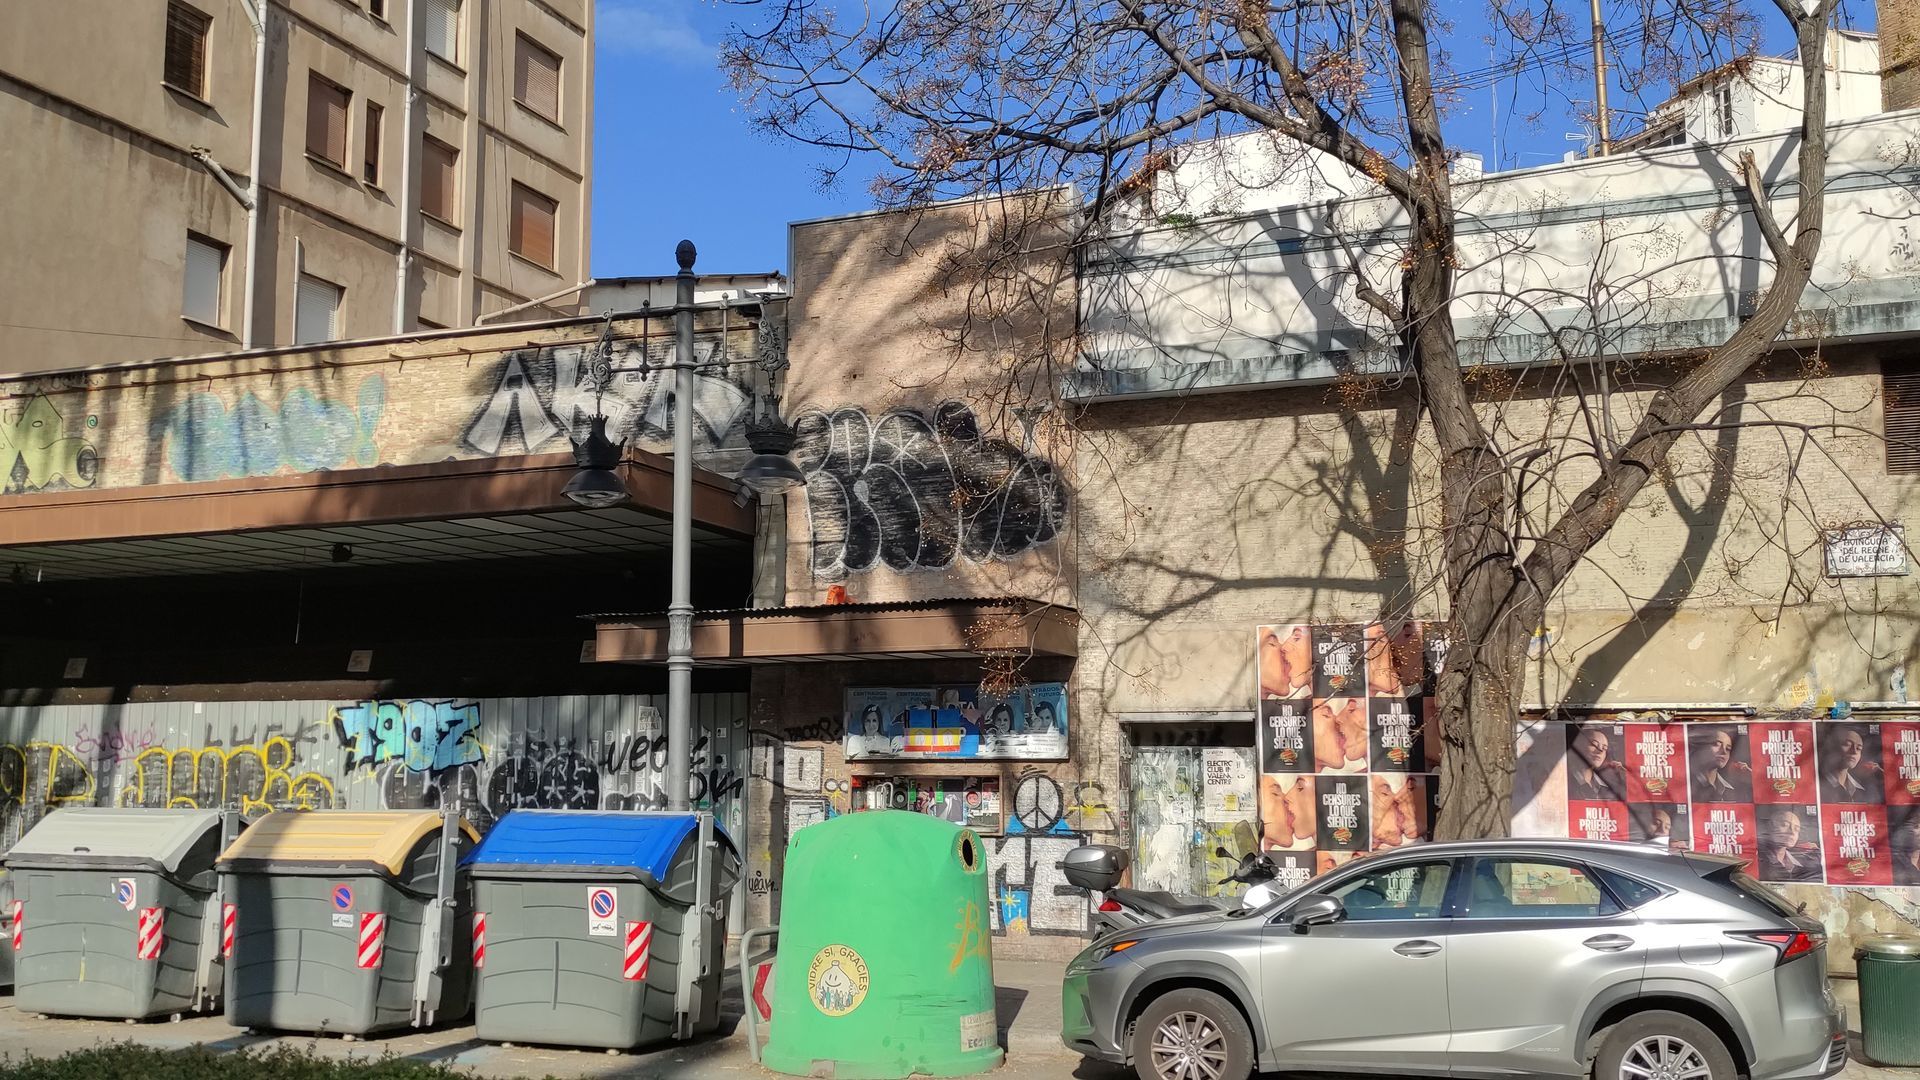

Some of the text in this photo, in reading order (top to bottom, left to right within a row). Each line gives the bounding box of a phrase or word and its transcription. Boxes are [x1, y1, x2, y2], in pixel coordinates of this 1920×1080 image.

[1843, 547, 1859, 555] DEL
[1326, 654, 1351, 664] LO QUE
[1323, 665, 1353, 675] SIENTES
[1282, 705, 1292, 716] NO
[1391, 703, 1402, 714] NO
[1270, 716, 1306, 727] CENSURES
[1377, 714, 1415, 725] CENSURES
[1276, 727, 1300, 738] LO QUE
[1384, 726, 1409, 736] LO QUE
[1768, 730, 1794, 742] NO LA
[1901, 730, 1914, 742] NO
[1382, 737, 1413, 748] SIENTES
[1643, 732, 1667, 743] NO LA
[1274, 738, 1303, 749] SIENTES
[1636, 743, 1674, 755] PRUEBES
[1762, 742, 1802, 754] PRUEBES
[1644, 755, 1668, 766] NO ES
[1771, 755, 1795, 766] NO ES
[1903, 755, 1915, 767] NO
[1640, 766, 1672, 778] PARA TI
[1766, 766, 1801, 778] PARA TI
[1336, 783, 1346, 794] NO
[1323, 794, 1361, 805] CENSURES
[1329, 805, 1355, 816] LO QUE
[1586, 808, 1610, 820] NO LA
[1711, 810, 1736, 822] NO LA
[1327, 817, 1357, 828] SIENTES
[1840, 812, 1867, 824] NO LA
[1580, 820, 1617, 832] PRUEBES
[1704, 822, 1744, 834] PRUEBES
[1834, 824, 1875, 836] PRUEBES
[1587, 832, 1610, 840] NO ES
[1713, 834, 1737, 845] NO ES
[1843, 836, 1869, 847] NO ES
[1709, 844, 1742, 854] PARA TI
[1839, 847, 1875, 858] PARA TI
[1285, 856, 1296, 868] NO
[1278, 867, 1310, 880] ENSURES
[1388, 878, 1414, 890] LO QUE
[1386, 889, 1417, 901] SIENTES
[810, 955, 823, 989] VIDRE
[840, 947, 867, 991] GRACIES
